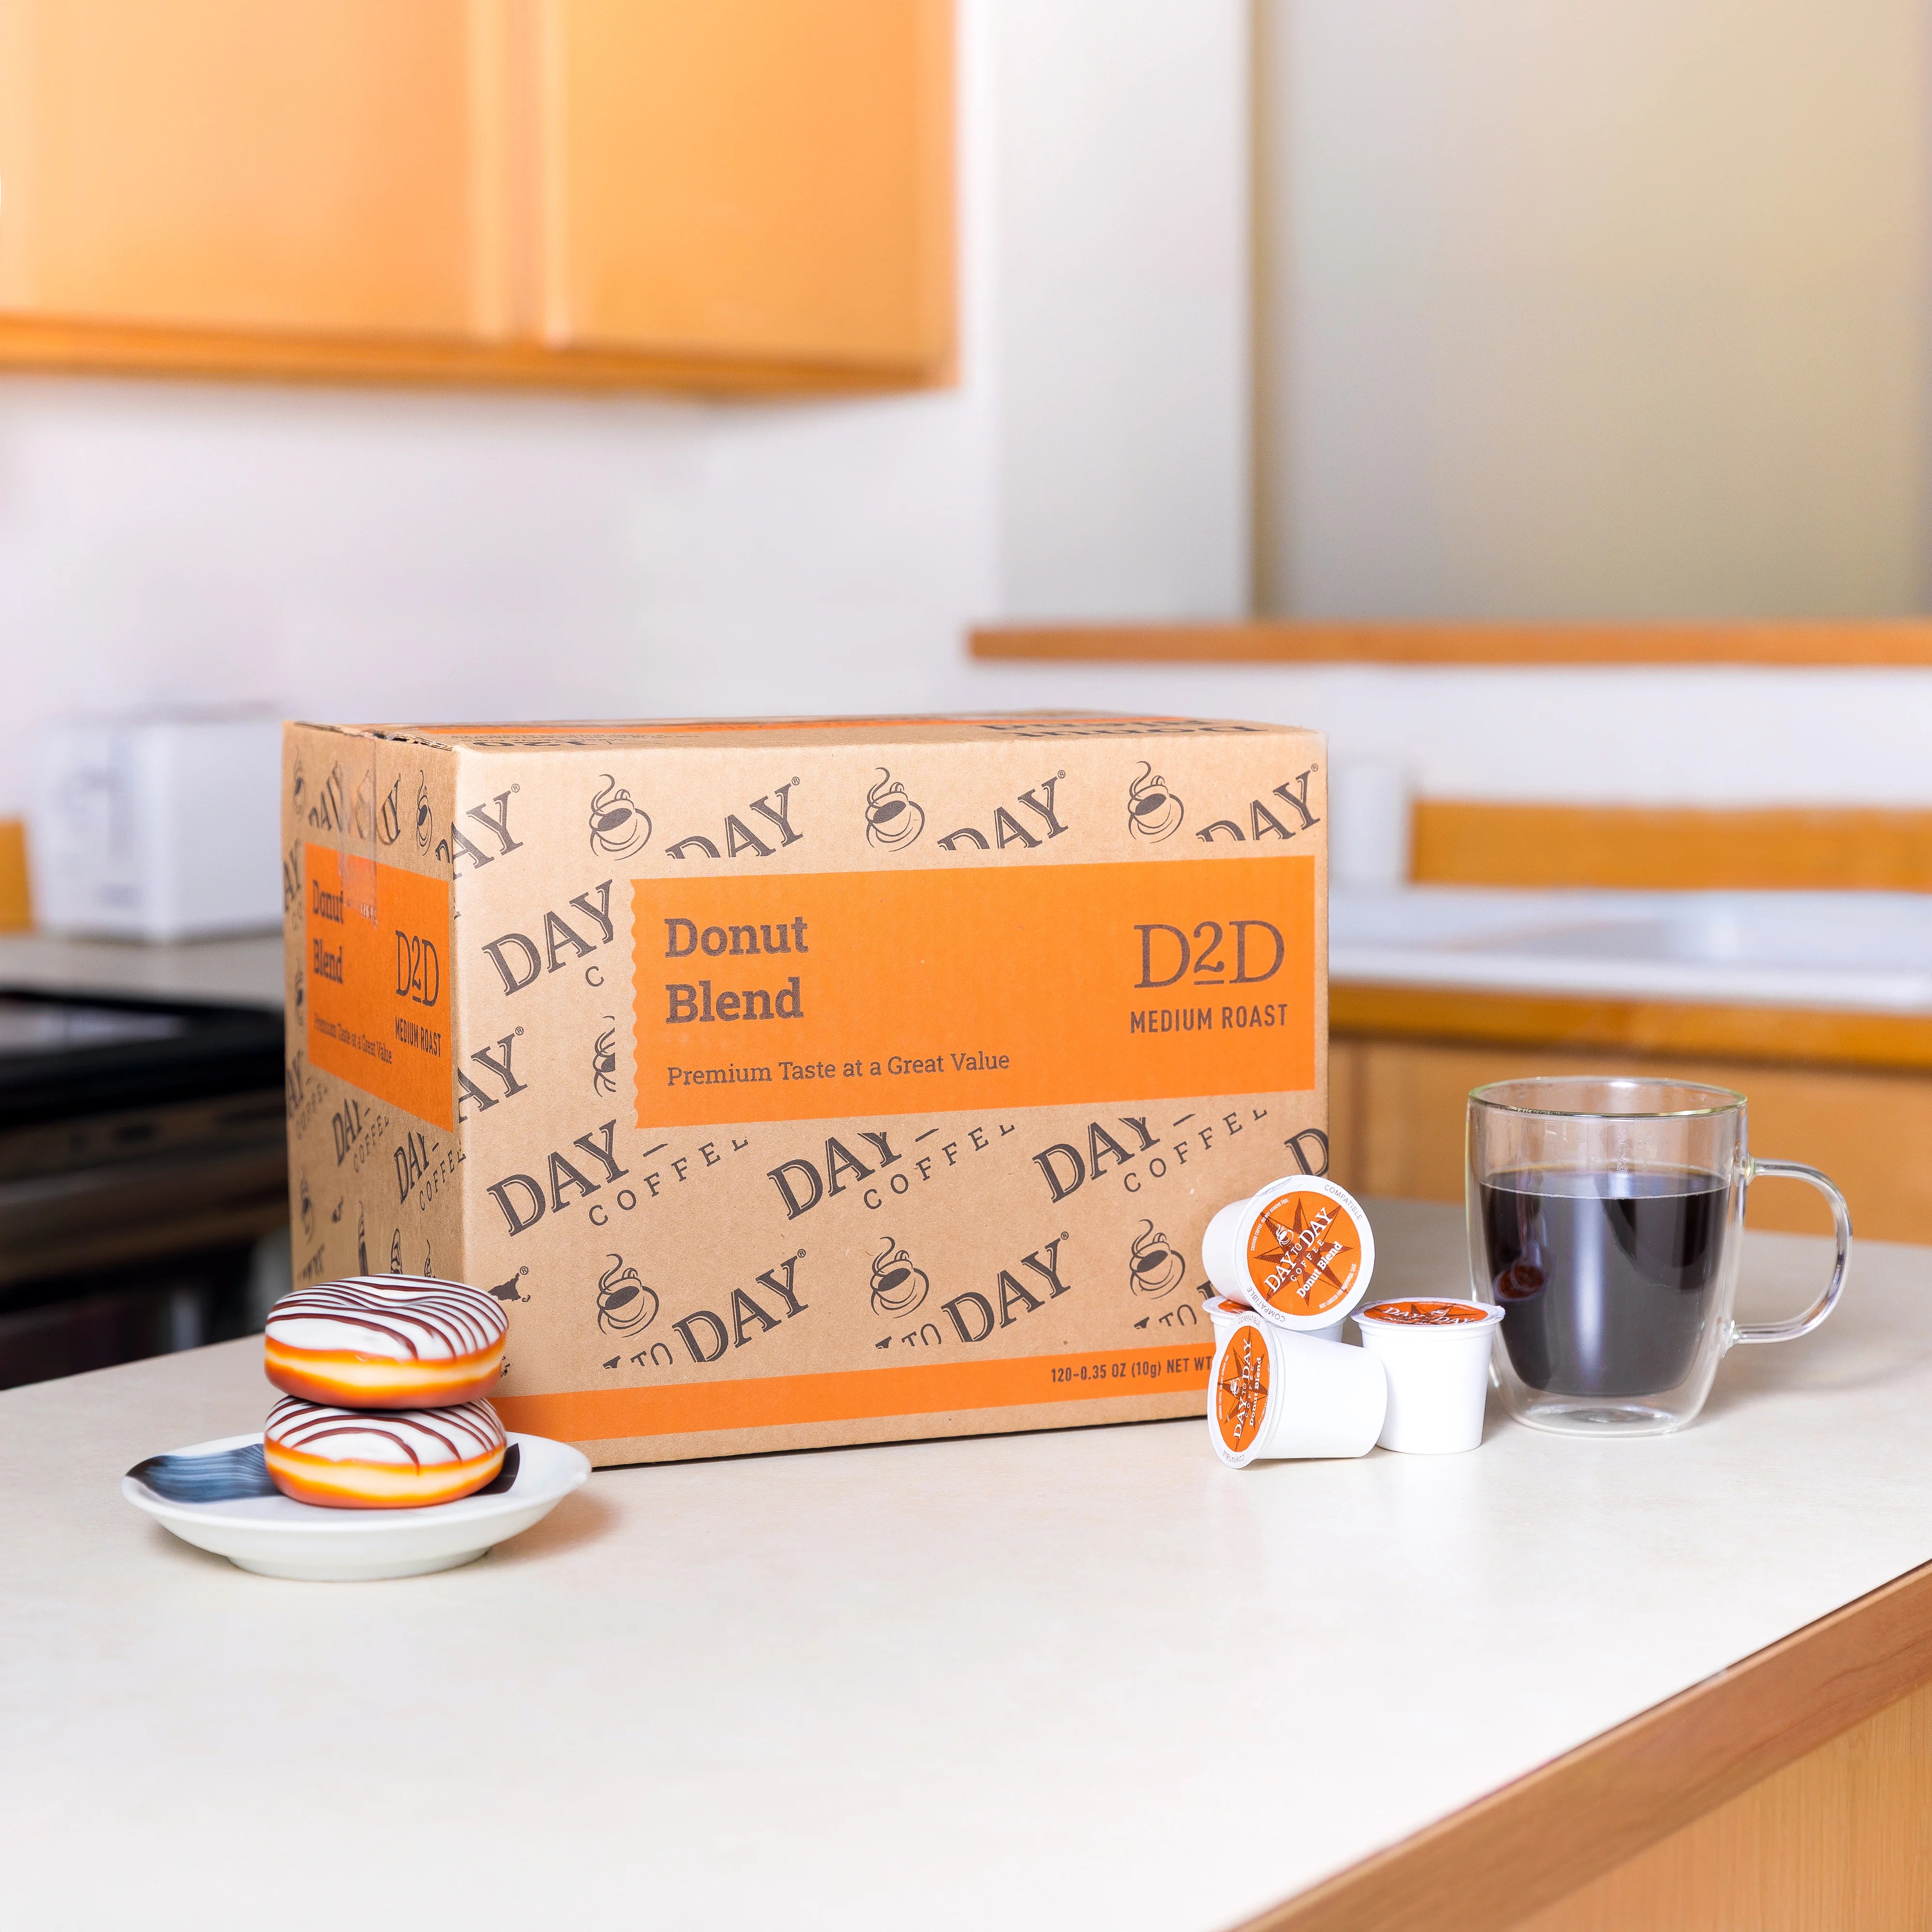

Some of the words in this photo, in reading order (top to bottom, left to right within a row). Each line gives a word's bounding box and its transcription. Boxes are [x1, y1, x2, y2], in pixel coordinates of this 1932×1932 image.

[312, 877, 344, 925] Donut
[482, 879, 613, 996] DAY
[664, 916, 809, 957] Donut
[1134, 921, 1284, 988] D2D
[312, 937, 344, 985] Blend
[395, 929, 440, 1008] D2D
[665, 977, 804, 1023] Blend
[1131, 1008, 1211, 1033] MEDIUM
[1222, 1004, 1287, 1029] ROAST
[351, 1033, 356, 1048] at
[357, 1036, 361, 1050] a
[362, 1034, 376, 1057] Great
[376, 1040, 392, 1065] Value
[395, 1015, 419, 1049] MEDIUM
[420, 1025, 441, 1058] ROAST
[668, 1063, 771, 1086] Premium
[778, 1062, 835, 1080] Taste
[843, 1060, 863, 1077] at
[870, 1062, 881, 1076] a
[888, 1055, 944, 1075] Great
[951, 1051, 1009, 1071] Value
[331, 1097, 363, 1168] DAY
[394, 1131, 430, 1205] DAY
[486, 1119, 630, 1236] DAY
[767, 1132, 903, 1220] DAY
[1032, 1117, 1160, 1203] DAY
[1269, 1201, 1282, 1213] REMOVE
[1324, 1184, 1363, 1221] COMPATIBLE
[1264, 1250, 1297, 1293] DAY
[1291, 1242, 1303, 1255] TO
[1298, 1207, 1333, 1248] DAY
[1290, 1238, 1325, 1282] COFFEE
[1296, 1268, 1321, 1298] Donut
[1317, 1240, 1343, 1271] Blend
[1237, 1315, 1261, 1327] COMPATIBLE
[1246, 1286, 1286, 1322] COMPATIBLE
[1325, 1293, 1339, 1306] LABELED
[1381, 1307, 1426, 1318] DAY
[1112, 1363, 1125, 1377] OZ
[1132, 1362, 1161, 1378] (10g)
[1167, 1358, 1189, 1373] NET
[1193, 1354, 1212, 1372] WT
[1242, 1337, 1251, 1381] DAY
[1241, 1383, 1247, 1395] TO
[1245, 1365, 1254, 1418] COFFEE
[1249, 1392, 1259, 1427] Donut
[1233, 1395, 1248, 1439] DAY
